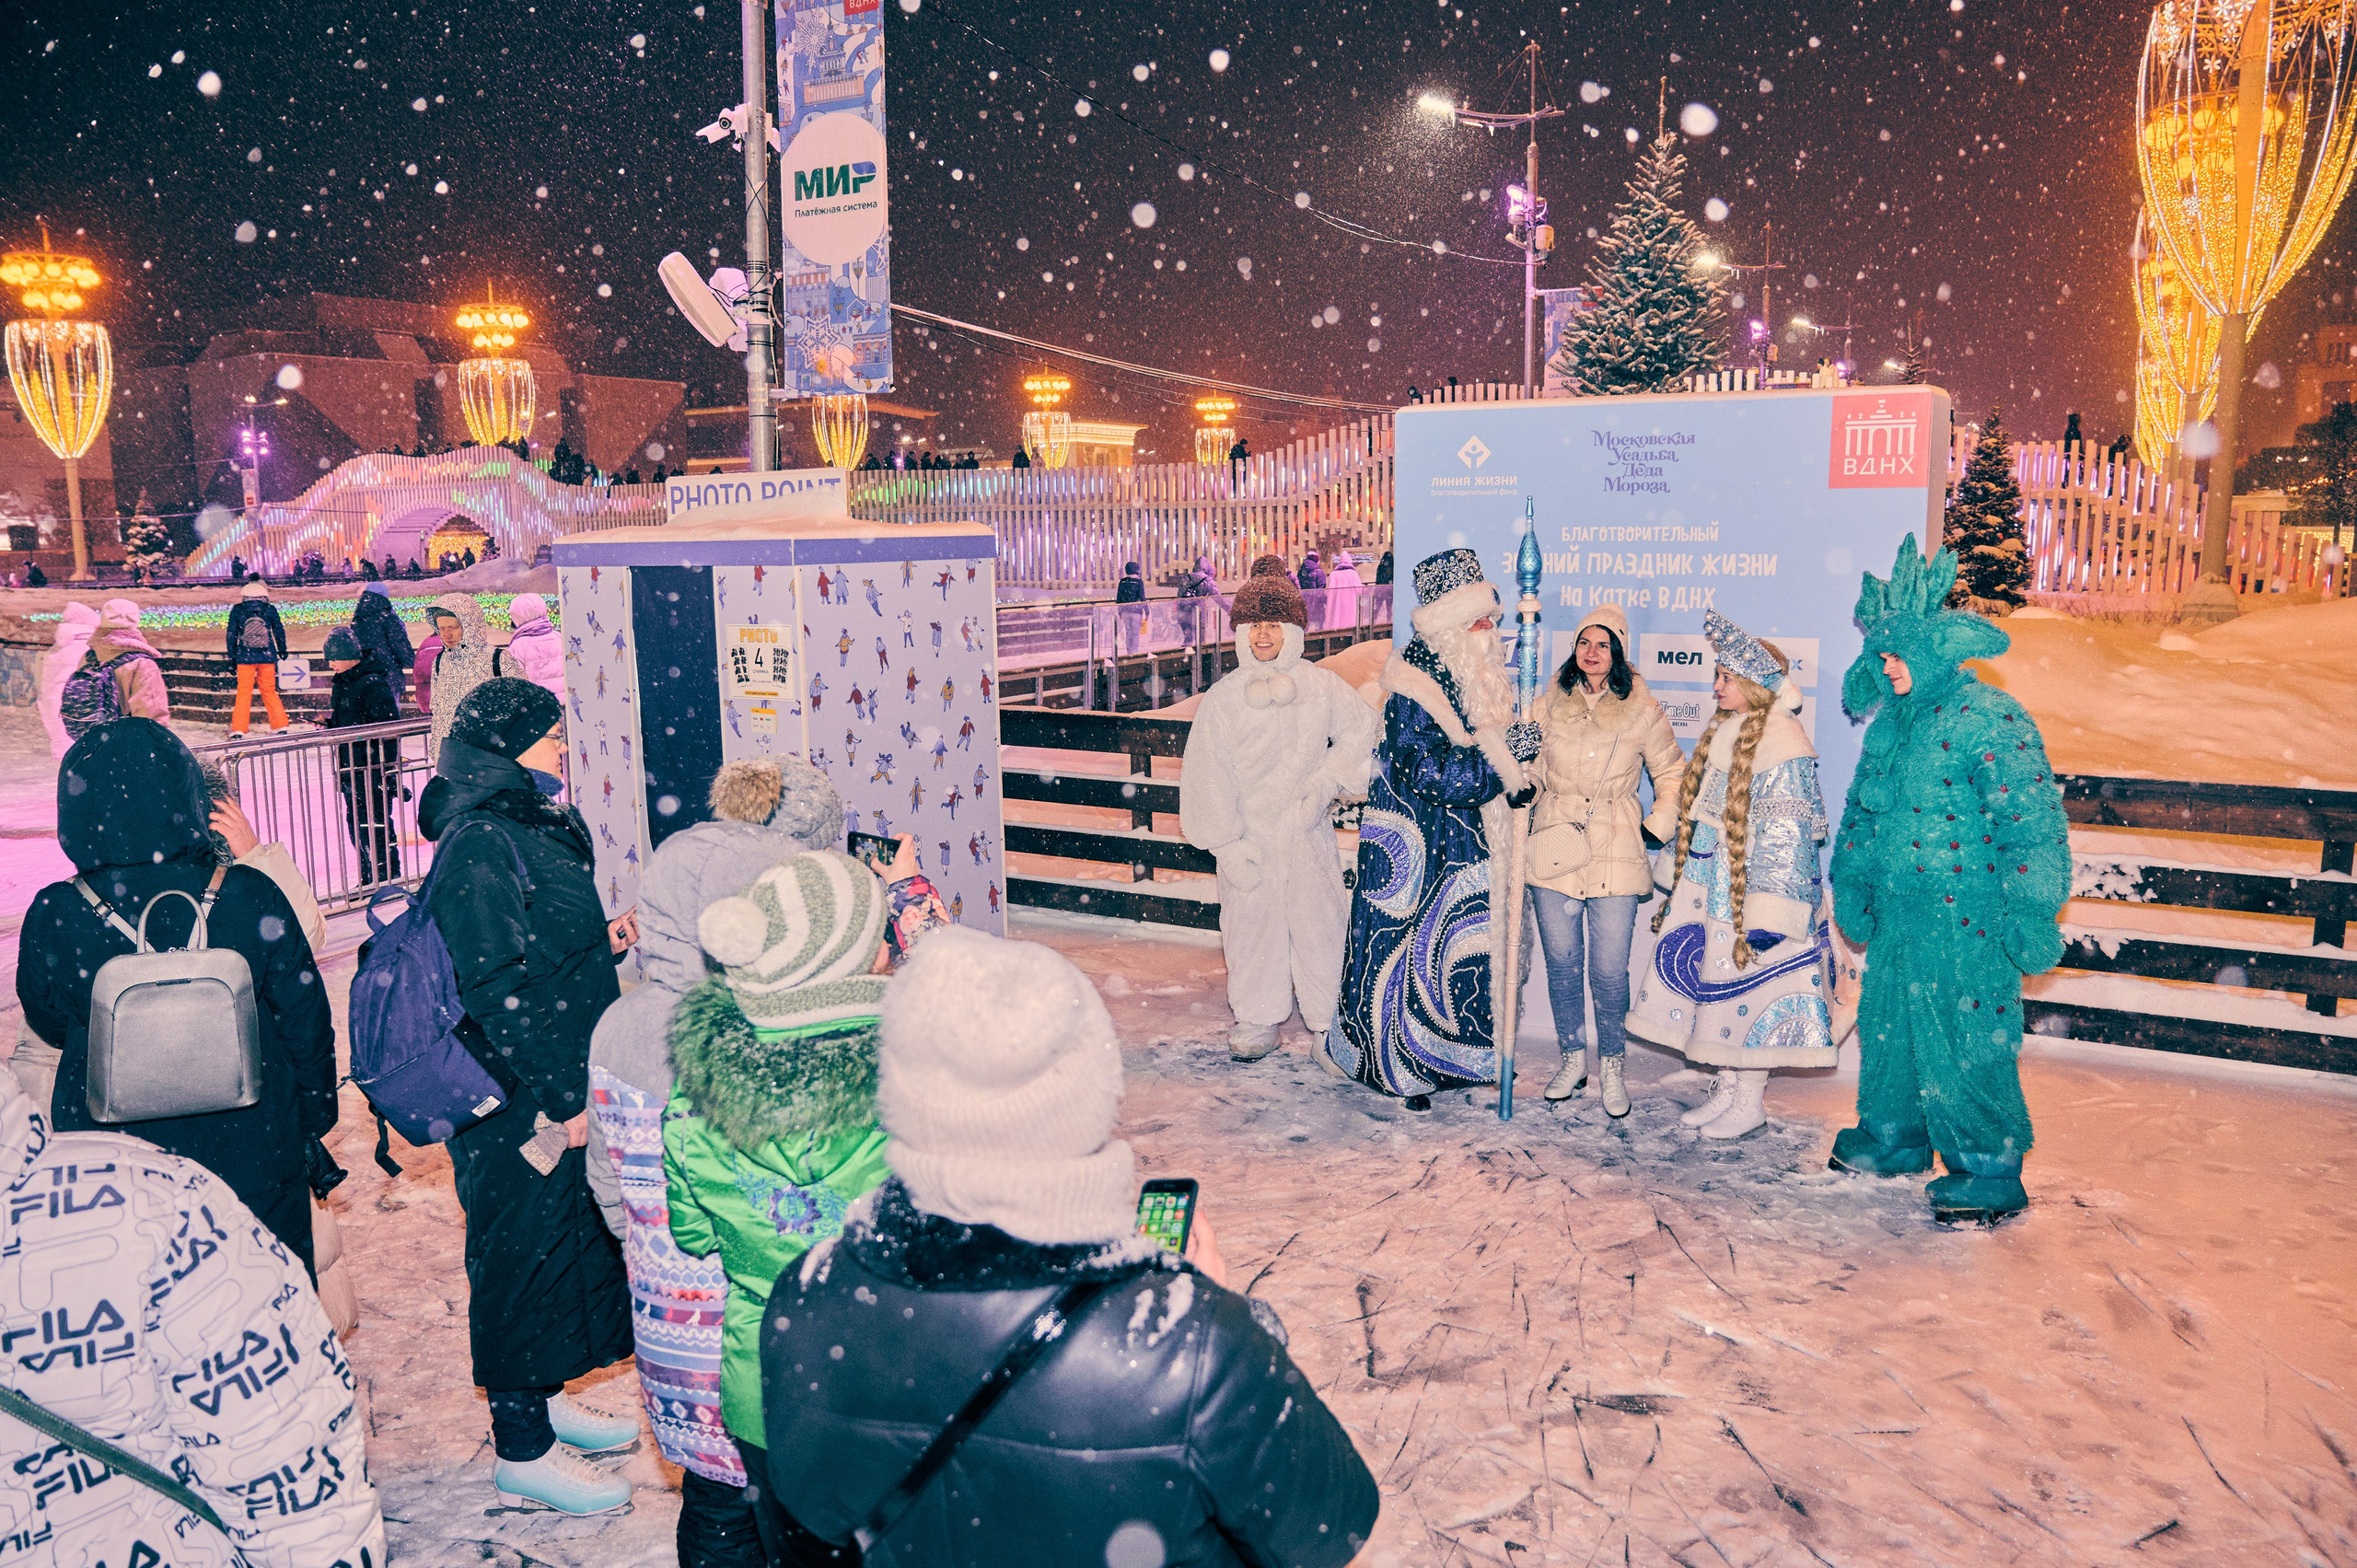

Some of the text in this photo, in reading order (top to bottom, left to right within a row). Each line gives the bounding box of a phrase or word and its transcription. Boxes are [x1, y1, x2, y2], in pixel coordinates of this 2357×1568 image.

[794, 160, 877, 202] МИР
[795, 201, 878, 218] Платёжная система
[1591, 430, 1696, 451] Московская
[1608, 446, 1679, 466] Усадьба
[1843, 457, 1915, 476] ВДНХ
[1431, 475, 1517, 487] ЛИНИЯ ЖИЗНИ
[1622, 462, 1664, 480] Деда
[1430, 487, 1517, 497] благотворительный фонд
[1603, 476, 1671, 495] Мороза
[670, 482, 751, 515] PHOTO
[1562, 520, 1719, 542] БЛАГОТВОРИТЕЛЬНЫЙ
[1502, 544, 1778, 579] ЗНИЙ ПРАЗДНИК ЖИЗНИ
[1658, 586, 1716, 611] ВДНХ
[754, 647, 763, 668] 4
[1657, 650, 1702, 665] мел
[1683, 703, 1701, 718] Out
[10, 1184, 126, 1225] FILA
[2, 1299, 125, 1353] FILA
[172, 1330, 269, 1393] FILA
[190, 1347, 289, 1416] FILA
[33, 1458, 125, 1510] FIL
[245, 1475, 338, 1519] FILA
